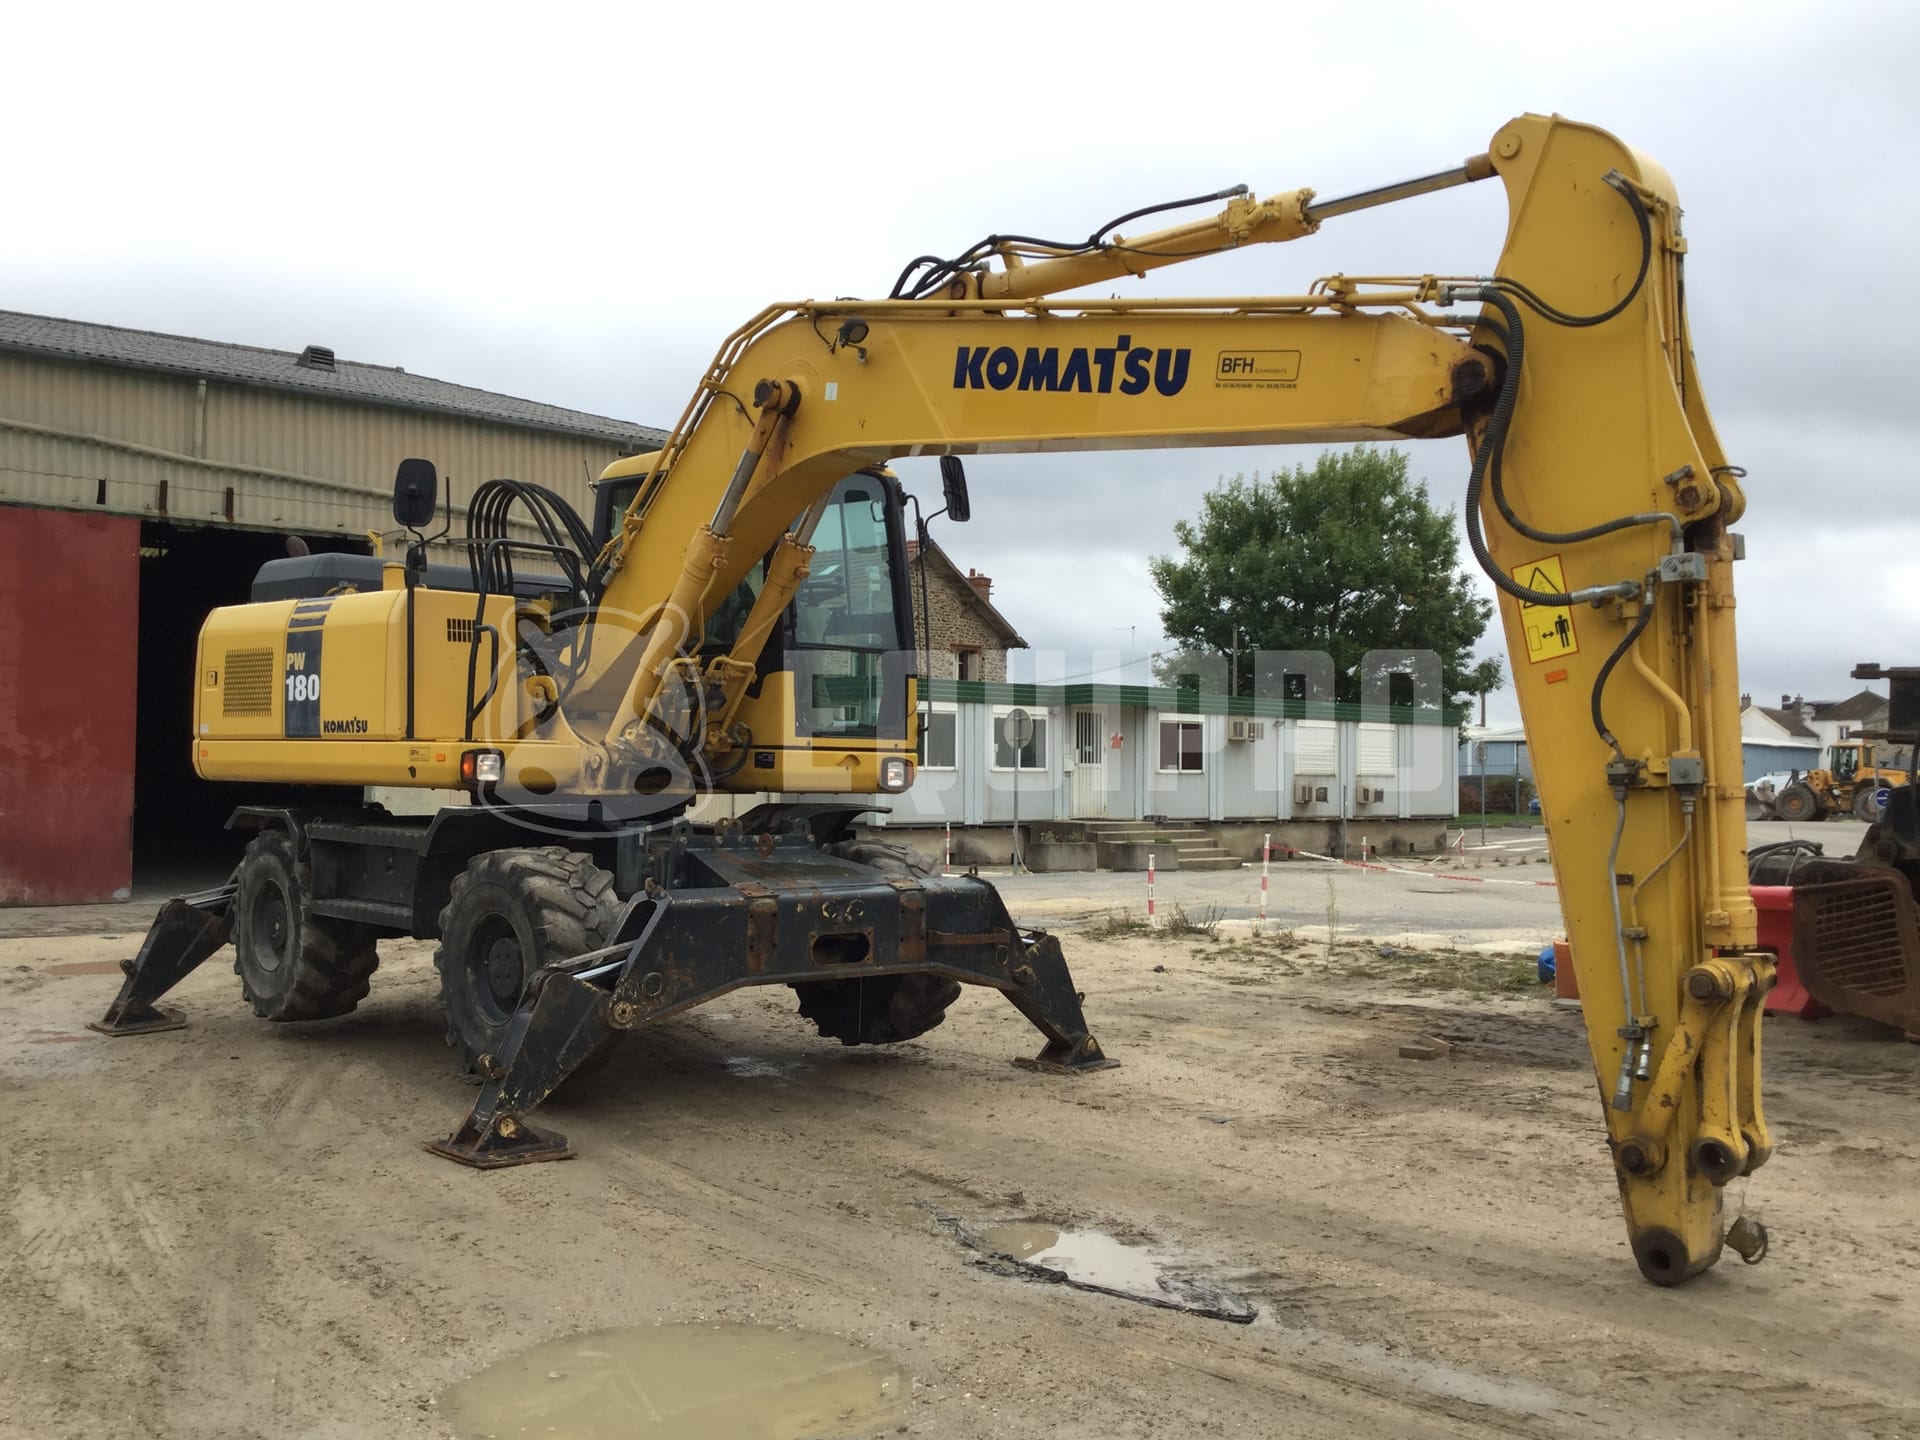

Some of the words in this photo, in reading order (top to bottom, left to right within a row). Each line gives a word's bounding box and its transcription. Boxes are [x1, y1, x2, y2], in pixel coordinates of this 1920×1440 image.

[953, 335, 1192, 397] KOMATSU
[1221, 357, 1255, 374] BFH
[286, 652, 306, 671] PW
[286, 674, 320, 701] 180
[323, 716, 368, 734] KOMATSU
